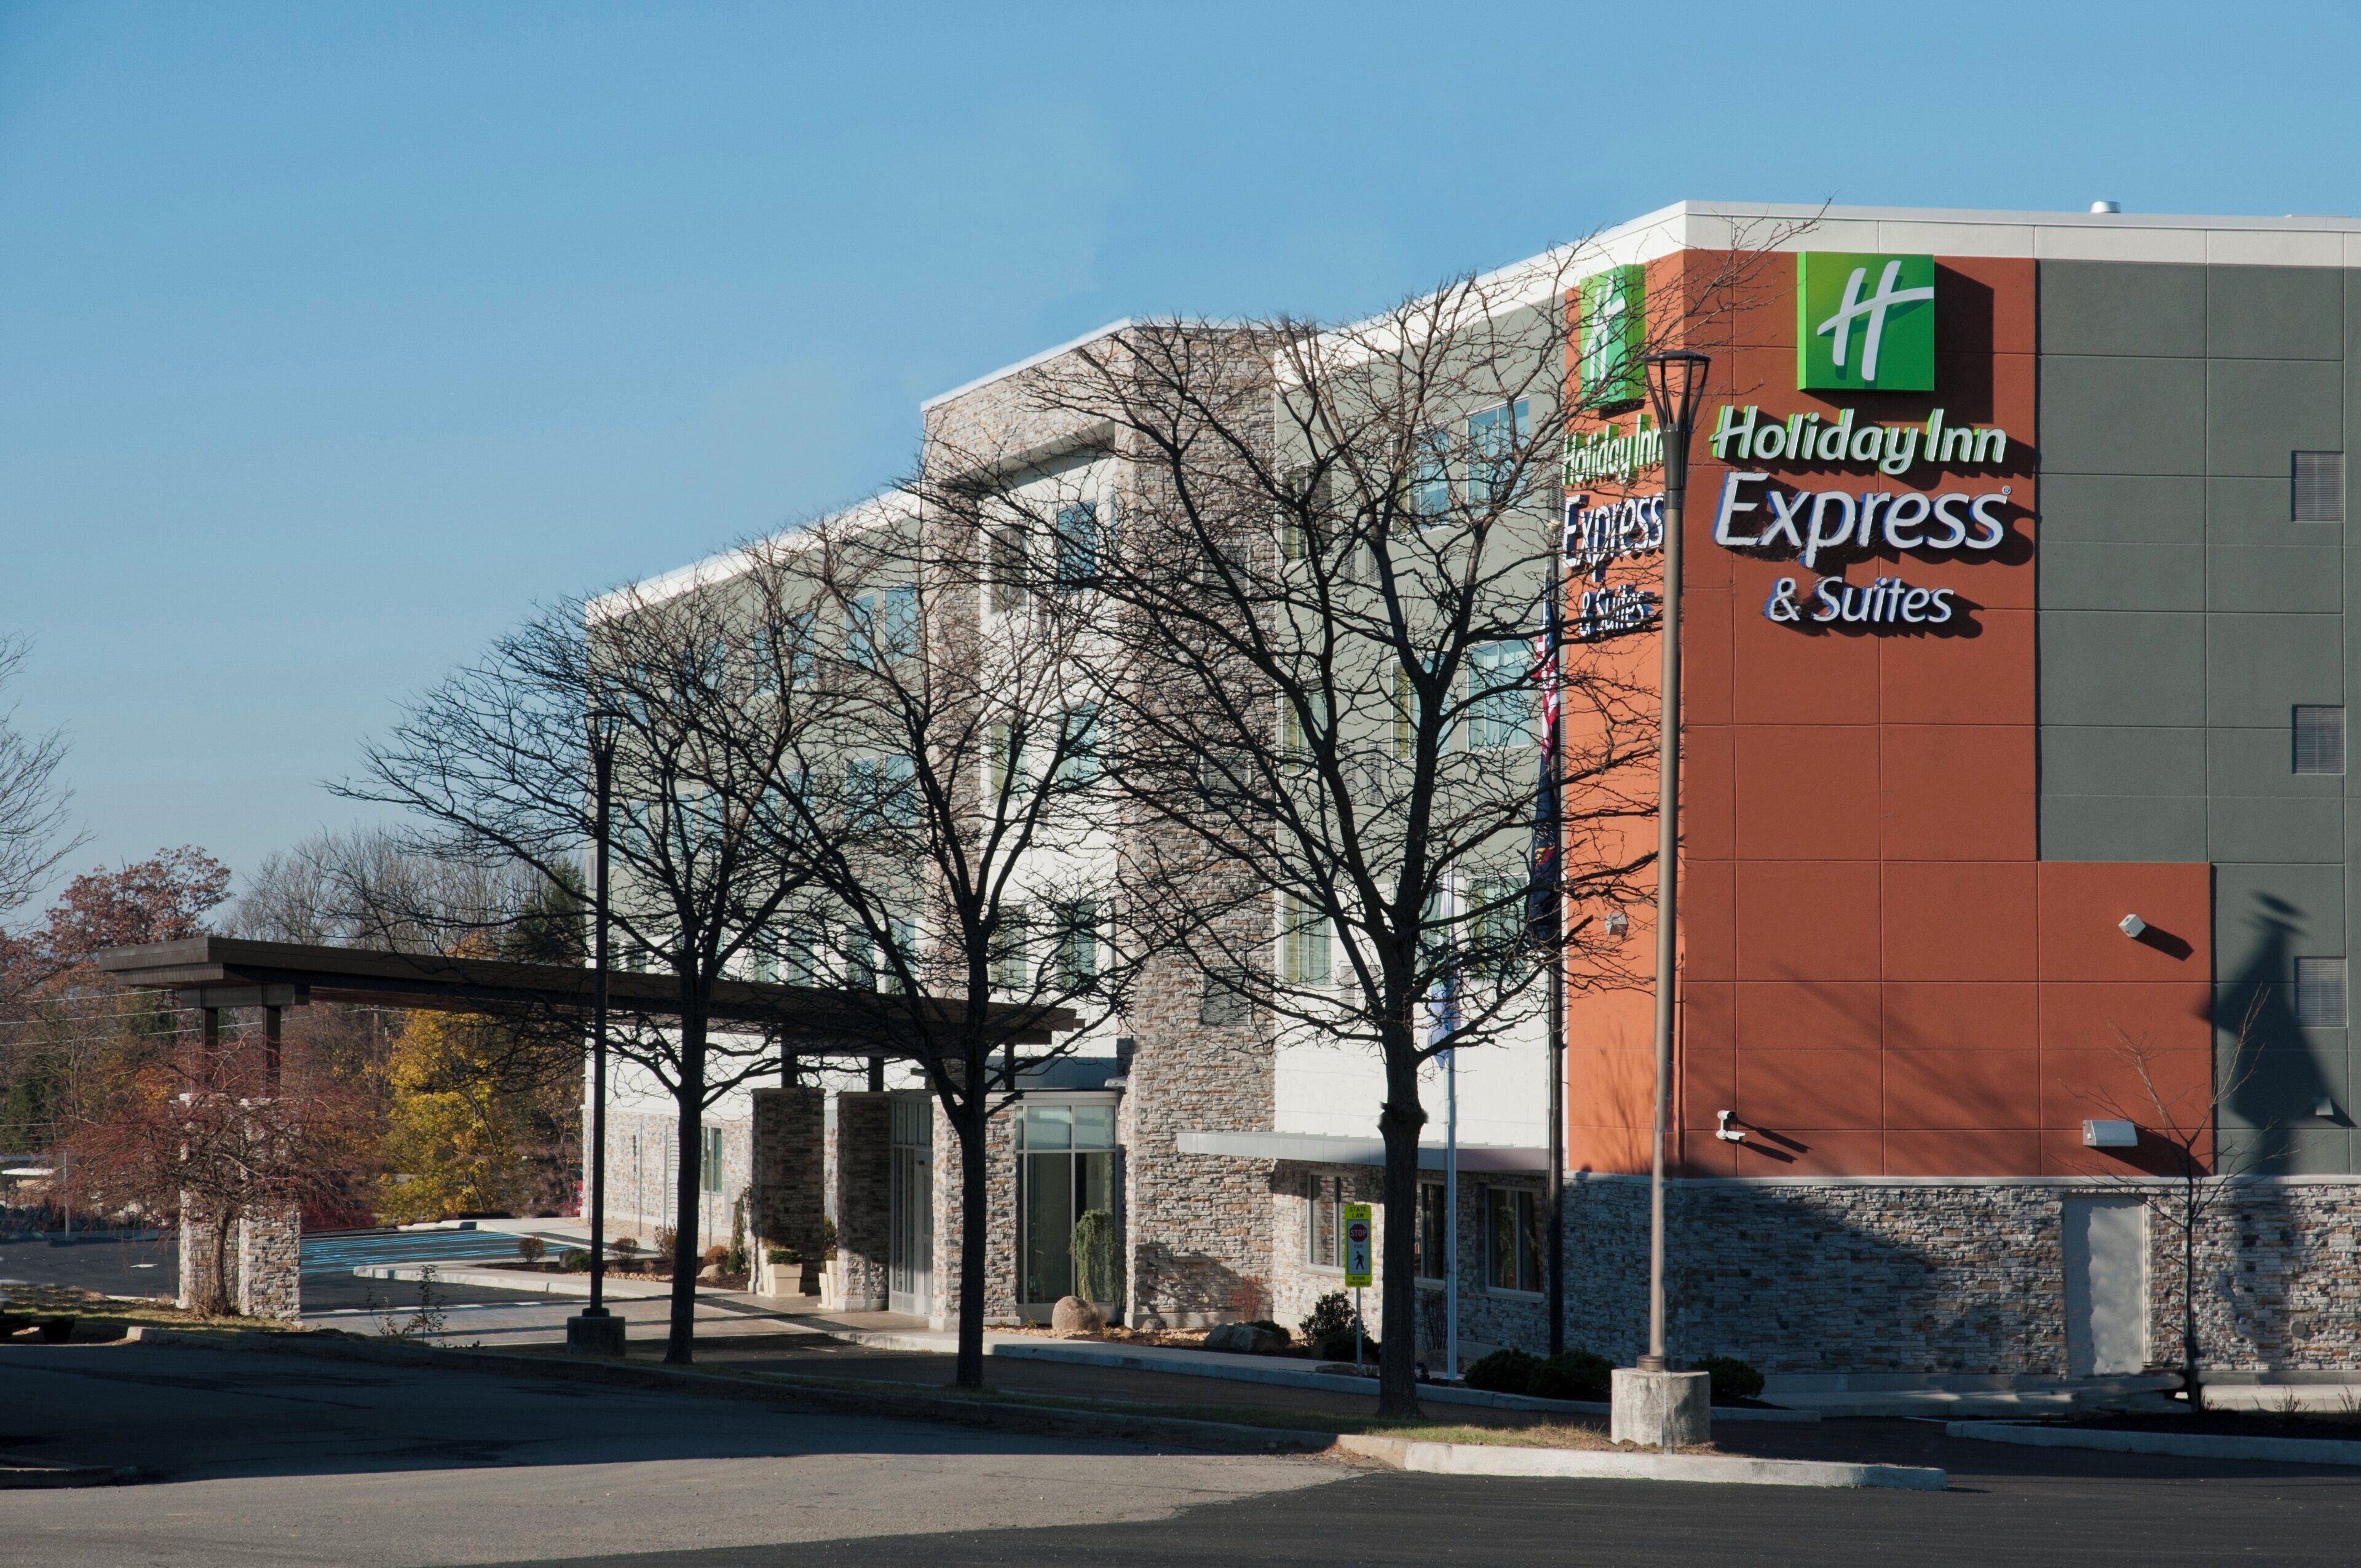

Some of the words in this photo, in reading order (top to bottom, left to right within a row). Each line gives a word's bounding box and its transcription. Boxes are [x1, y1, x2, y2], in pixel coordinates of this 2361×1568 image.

[1562, 424, 1635, 485] Holiday
[1709, 405, 1919, 475] Holiday
[1925, 408, 2007, 463] Inn
[1562, 491, 1664, 583] Express
[1765, 577, 1800, 622] &
[1811, 576, 1955, 623] Suites
